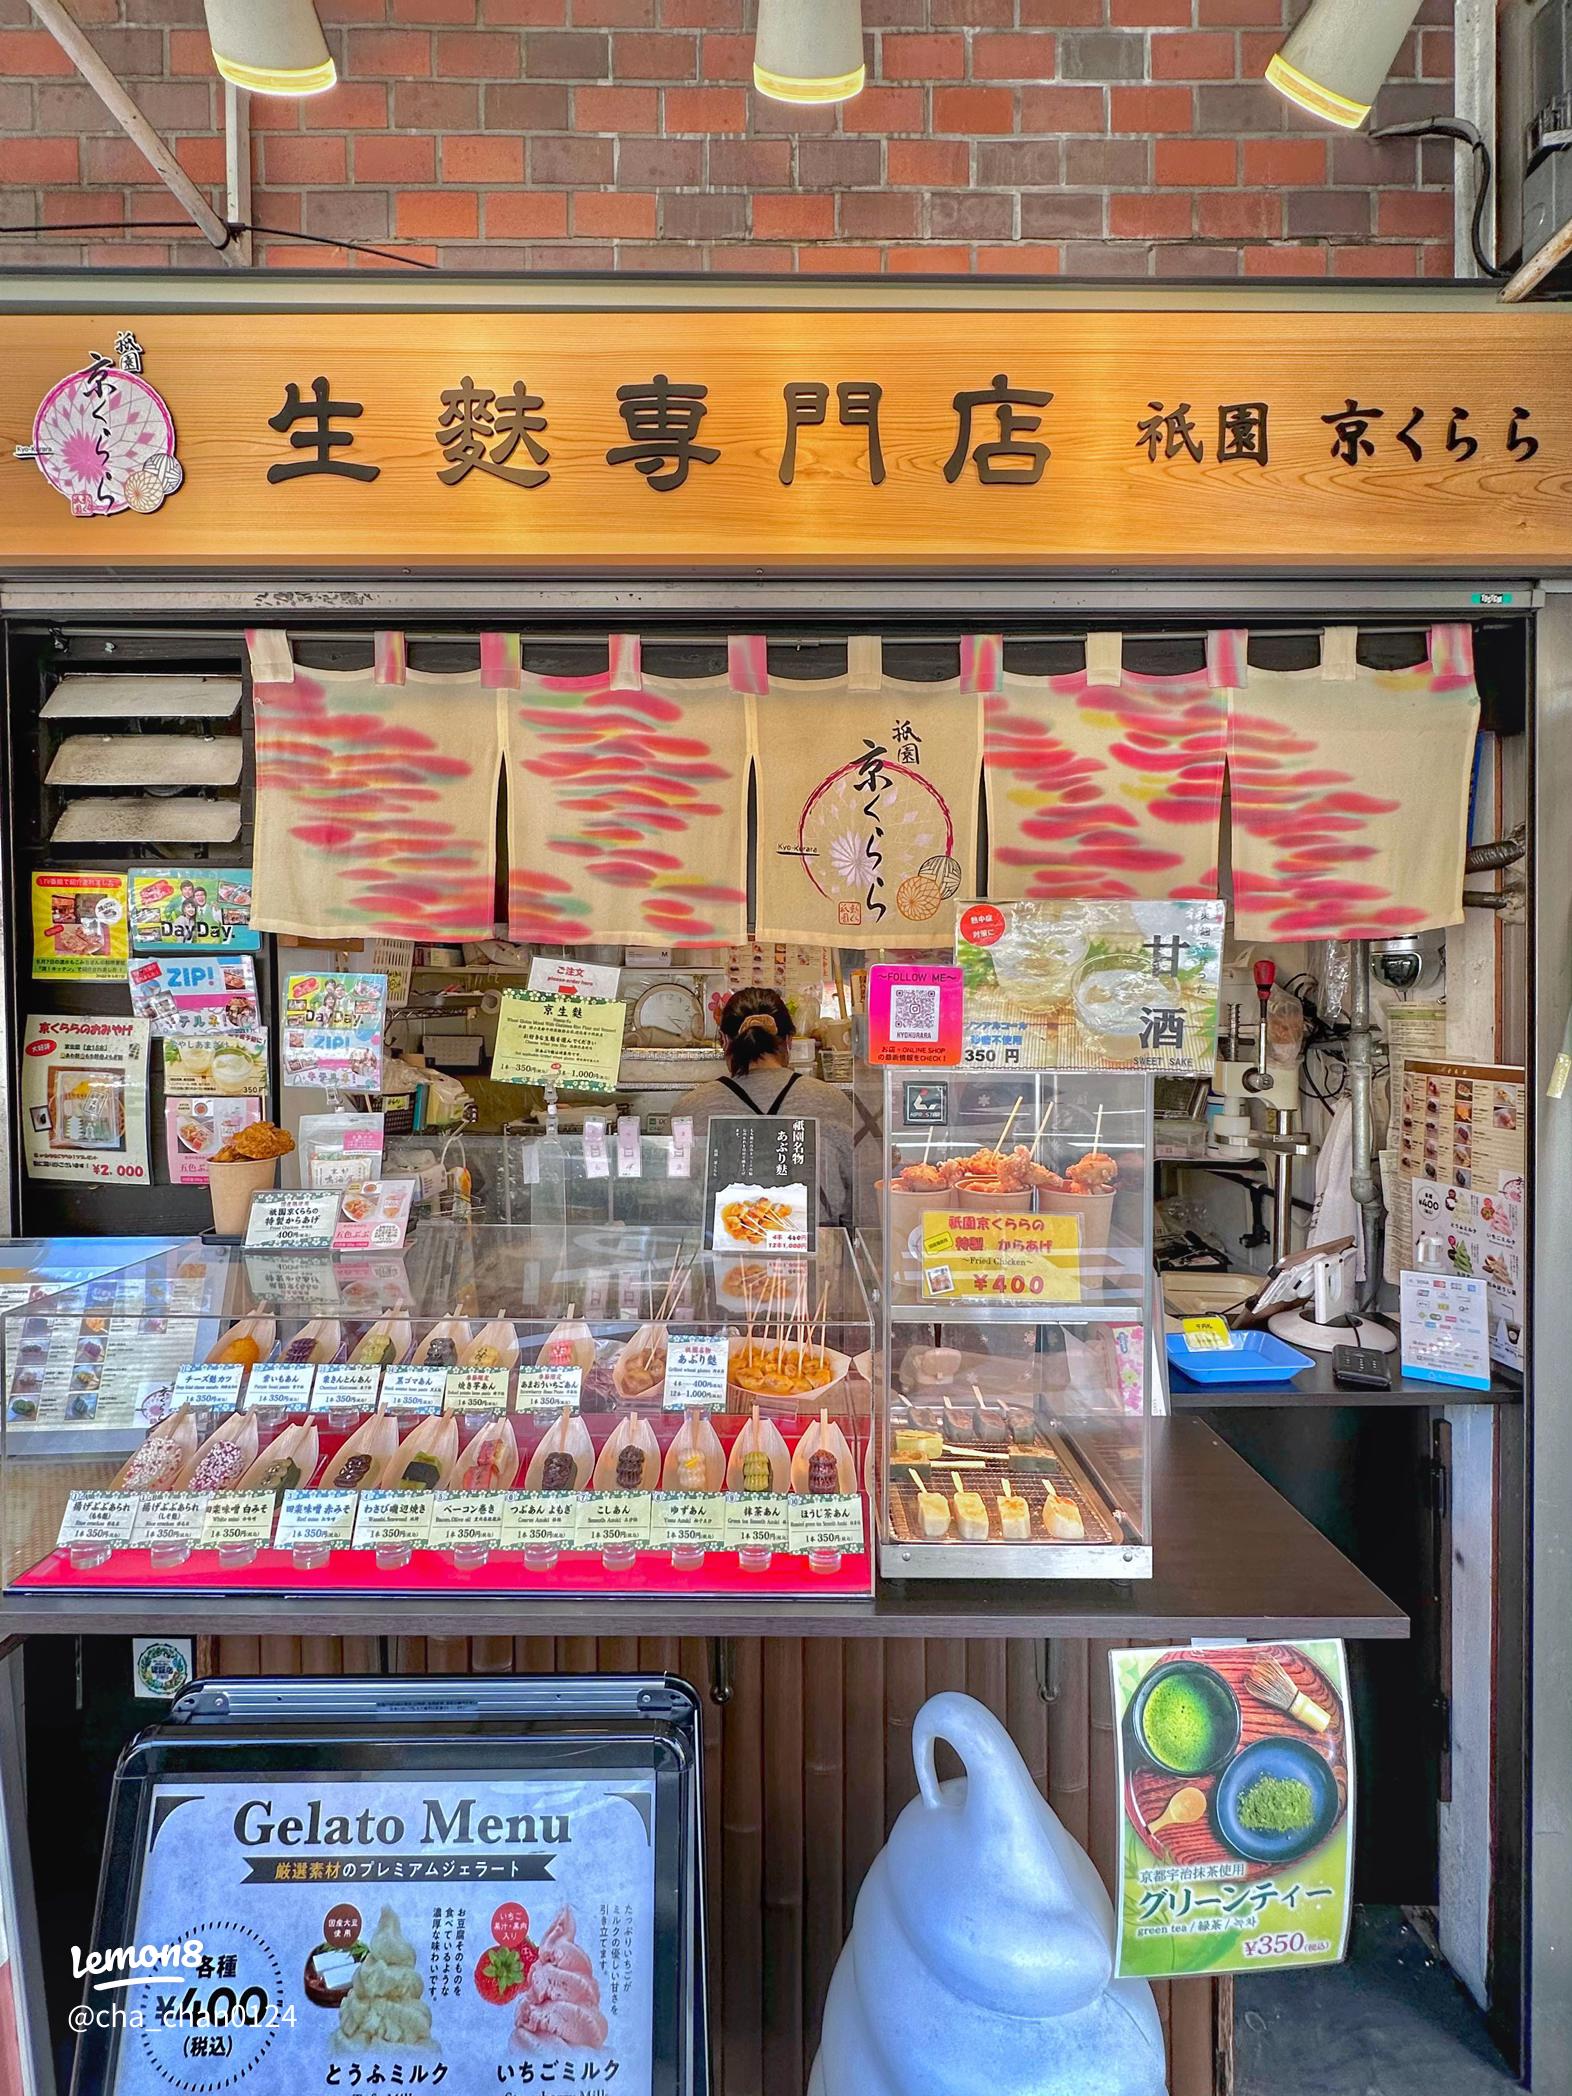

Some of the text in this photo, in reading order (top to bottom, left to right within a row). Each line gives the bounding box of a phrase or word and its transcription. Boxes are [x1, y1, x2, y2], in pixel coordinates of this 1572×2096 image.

[1136, 397, 1541, 467] 祇園 京くらら
[892, 720, 922, 765] 祇園
[850, 739, 894, 923] 京くらら
[166, 966, 215, 988] ZIP!
[1139, 935, 1191, 1049] 甘酒
[38, 1022, 133, 1036] 京くららのおみやげ
[964, 1049, 1020, 1063] 350 円
[1133, 1056, 1193, 1067] SWEET SAKE
[265, 1216, 320, 1225] 特製からあげ
[948, 1216, 1045, 1231] 祇園京くららの
[955, 1236, 1053, 1253] 特製 からあげ
[597, 1505, 630, 1514] こしあん
[671, 1506, 707, 1515] ゆずあん
[801, 1508, 850, 1518] ほうじ茶あん
[233, 1798, 573, 1846] Gelato Menu
[273, 1859, 520, 1881] 厳選素材のプレミアムジェラート
[1139, 1863, 1245, 1883] 京都宇治抹茶使用
[1139, 1882, 1333, 1920] グリーンティー
[1137, 1925, 1167, 1937] green
[1171, 1924, 1187, 1933] tea
[441, 1907, 455, 1997] 食べているような
[453, 1907, 467, 1997] お豆腐そのものを
[325, 2061, 448, 2086] とうふミルク
[496, 2059, 620, 2085] いちごミルク
